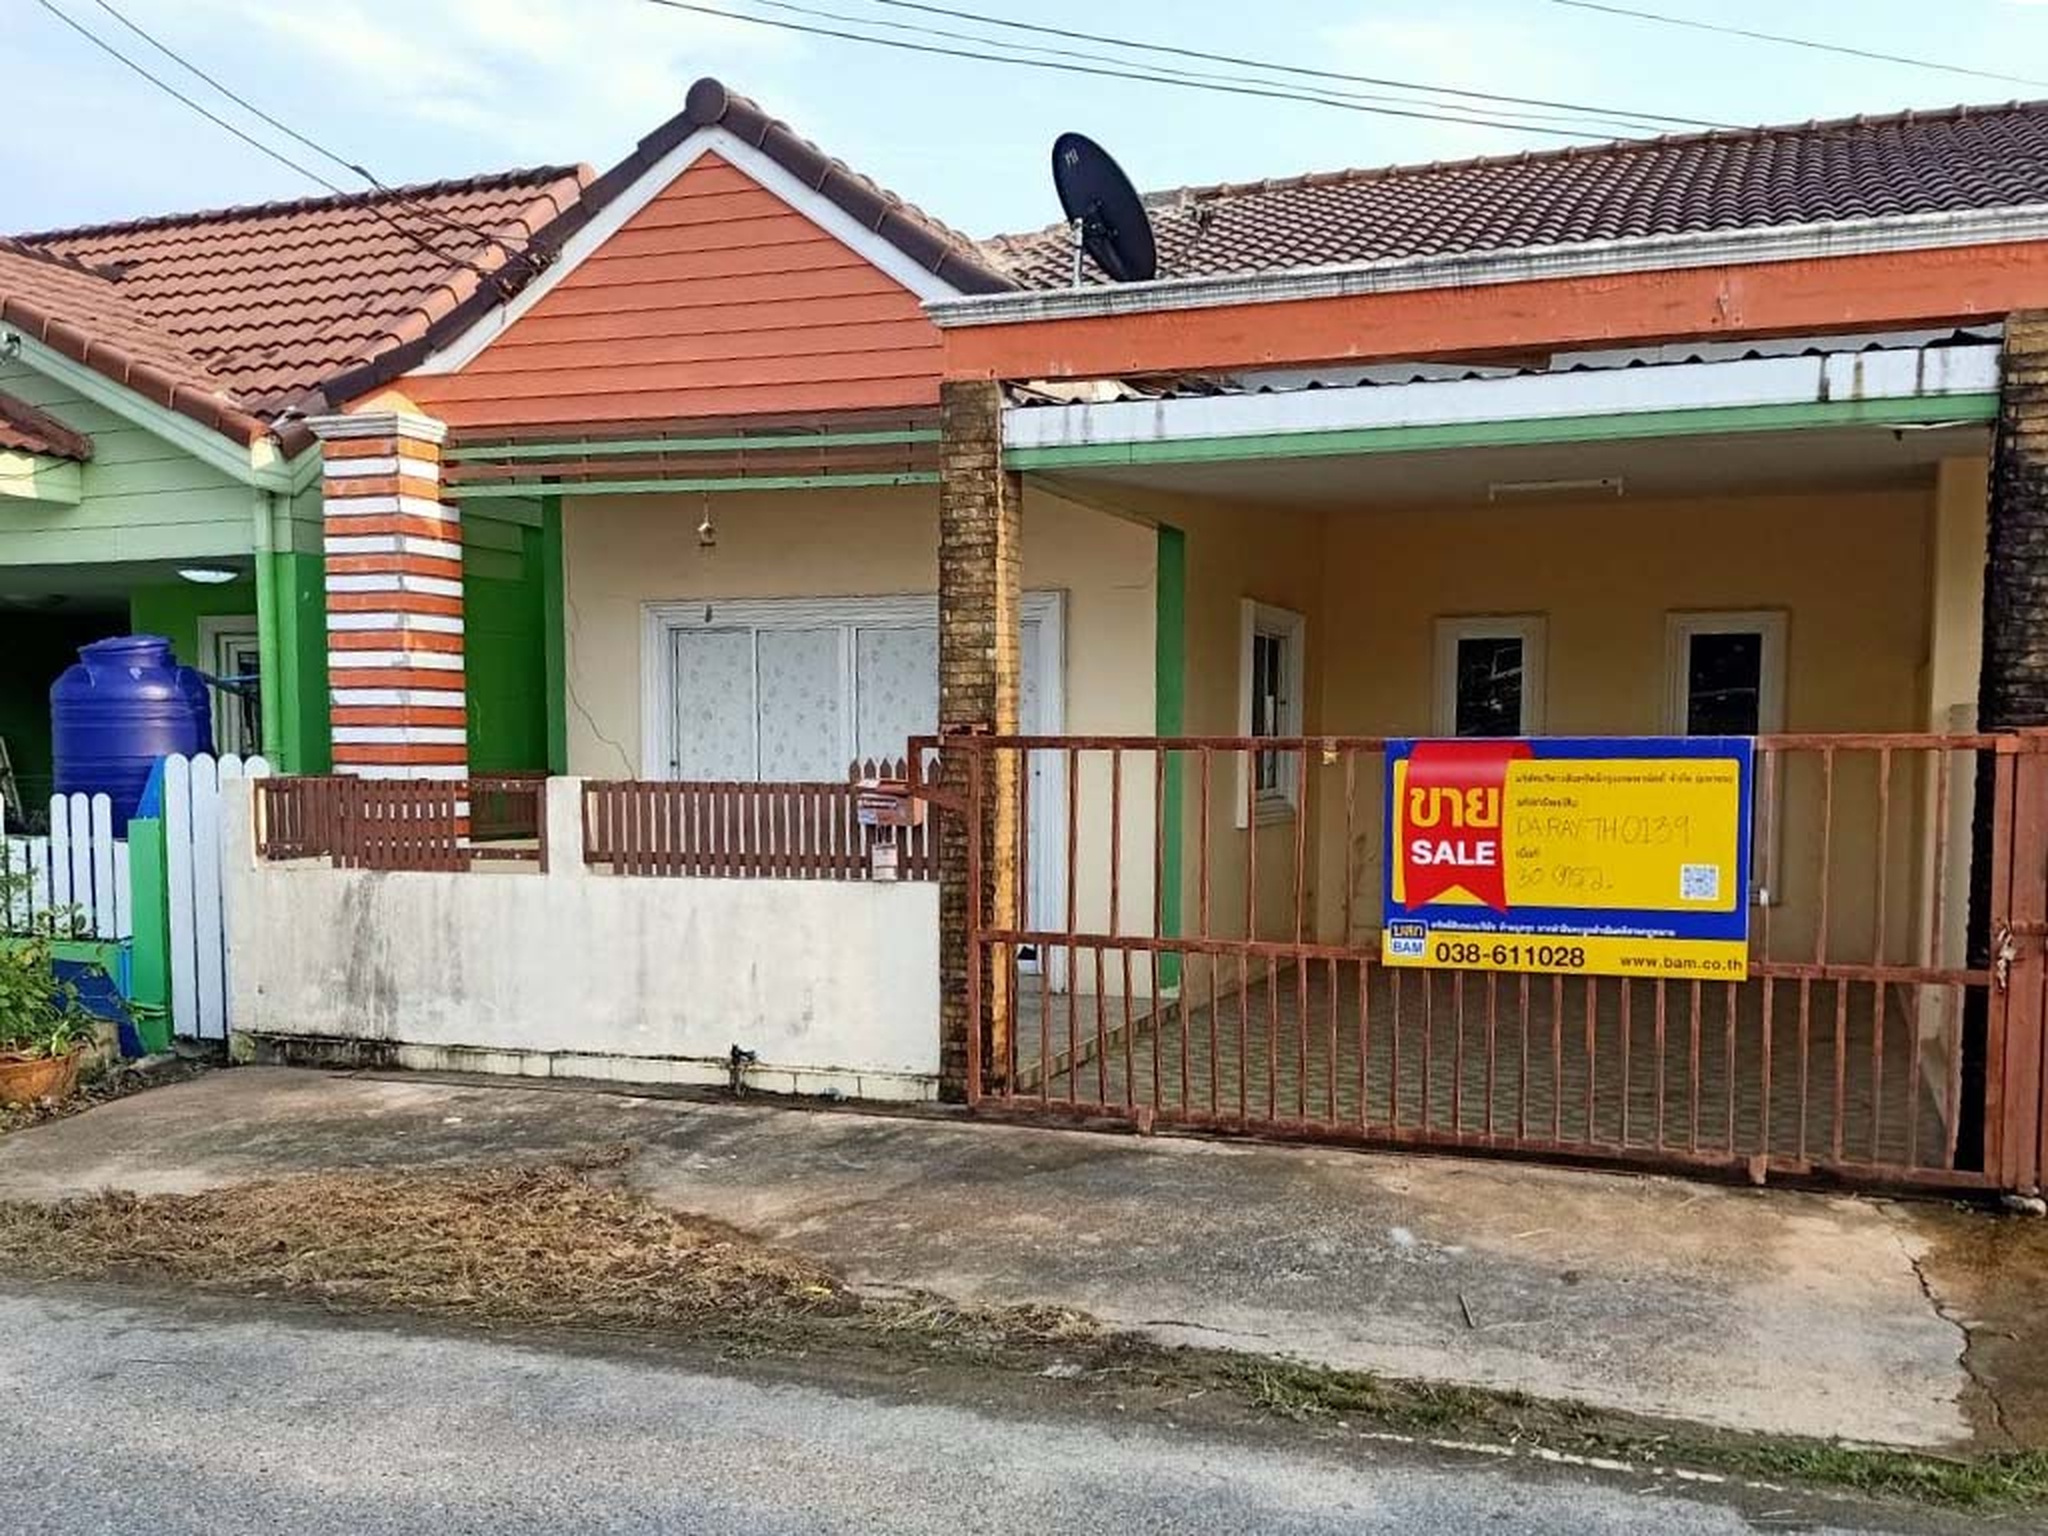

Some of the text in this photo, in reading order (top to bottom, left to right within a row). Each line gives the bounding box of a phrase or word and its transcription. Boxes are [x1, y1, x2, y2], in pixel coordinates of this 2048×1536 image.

[1410, 787, 1499, 828] ขาย
[1411, 840, 1496, 865] SALE
[1392, 941, 1423, 954] BAM
[1436, 942, 1585, 968] 038-611028
[1620, 954, 1743, 973] www.bam.co.th
